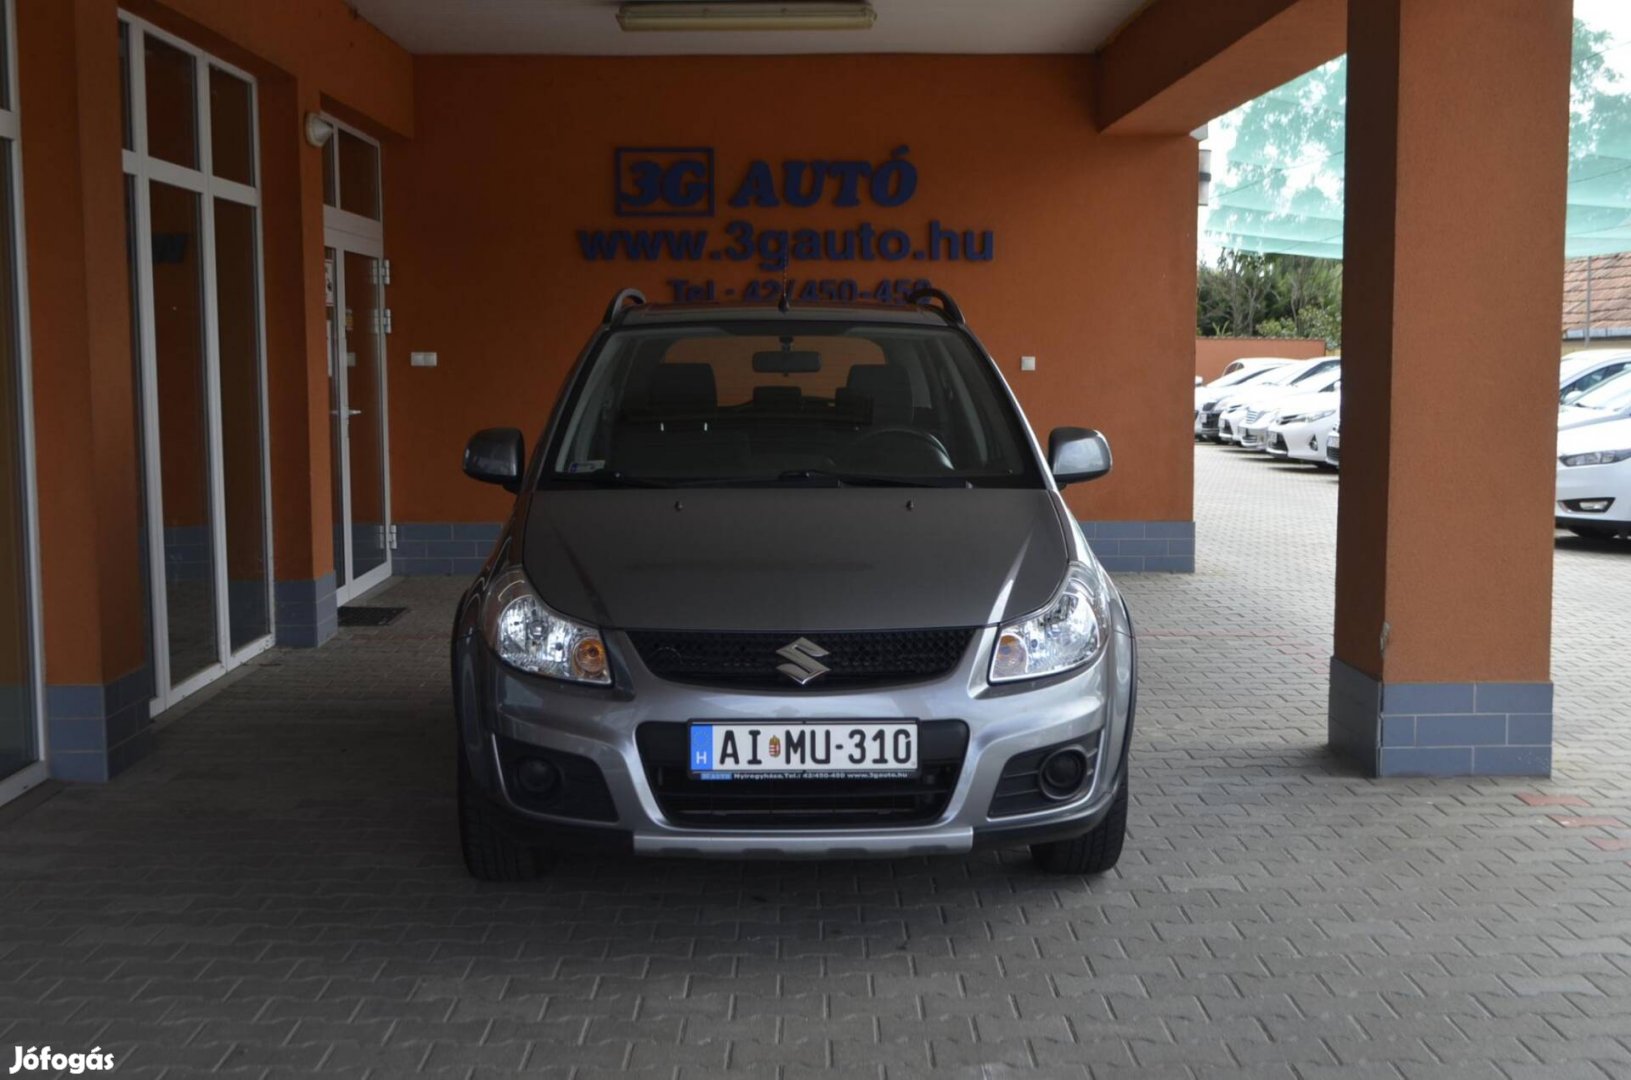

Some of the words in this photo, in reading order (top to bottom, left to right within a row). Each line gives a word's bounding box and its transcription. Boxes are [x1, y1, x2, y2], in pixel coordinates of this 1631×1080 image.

[619, 160, 707, 207] 3G
[730, 145, 918, 208] AUTÓ
[577, 220, 994, 272] www.3gauto.hu
[696, 751, 707, 765] H
[719, 729, 762, 765] AI
[785, 729, 911, 765] MU-310
